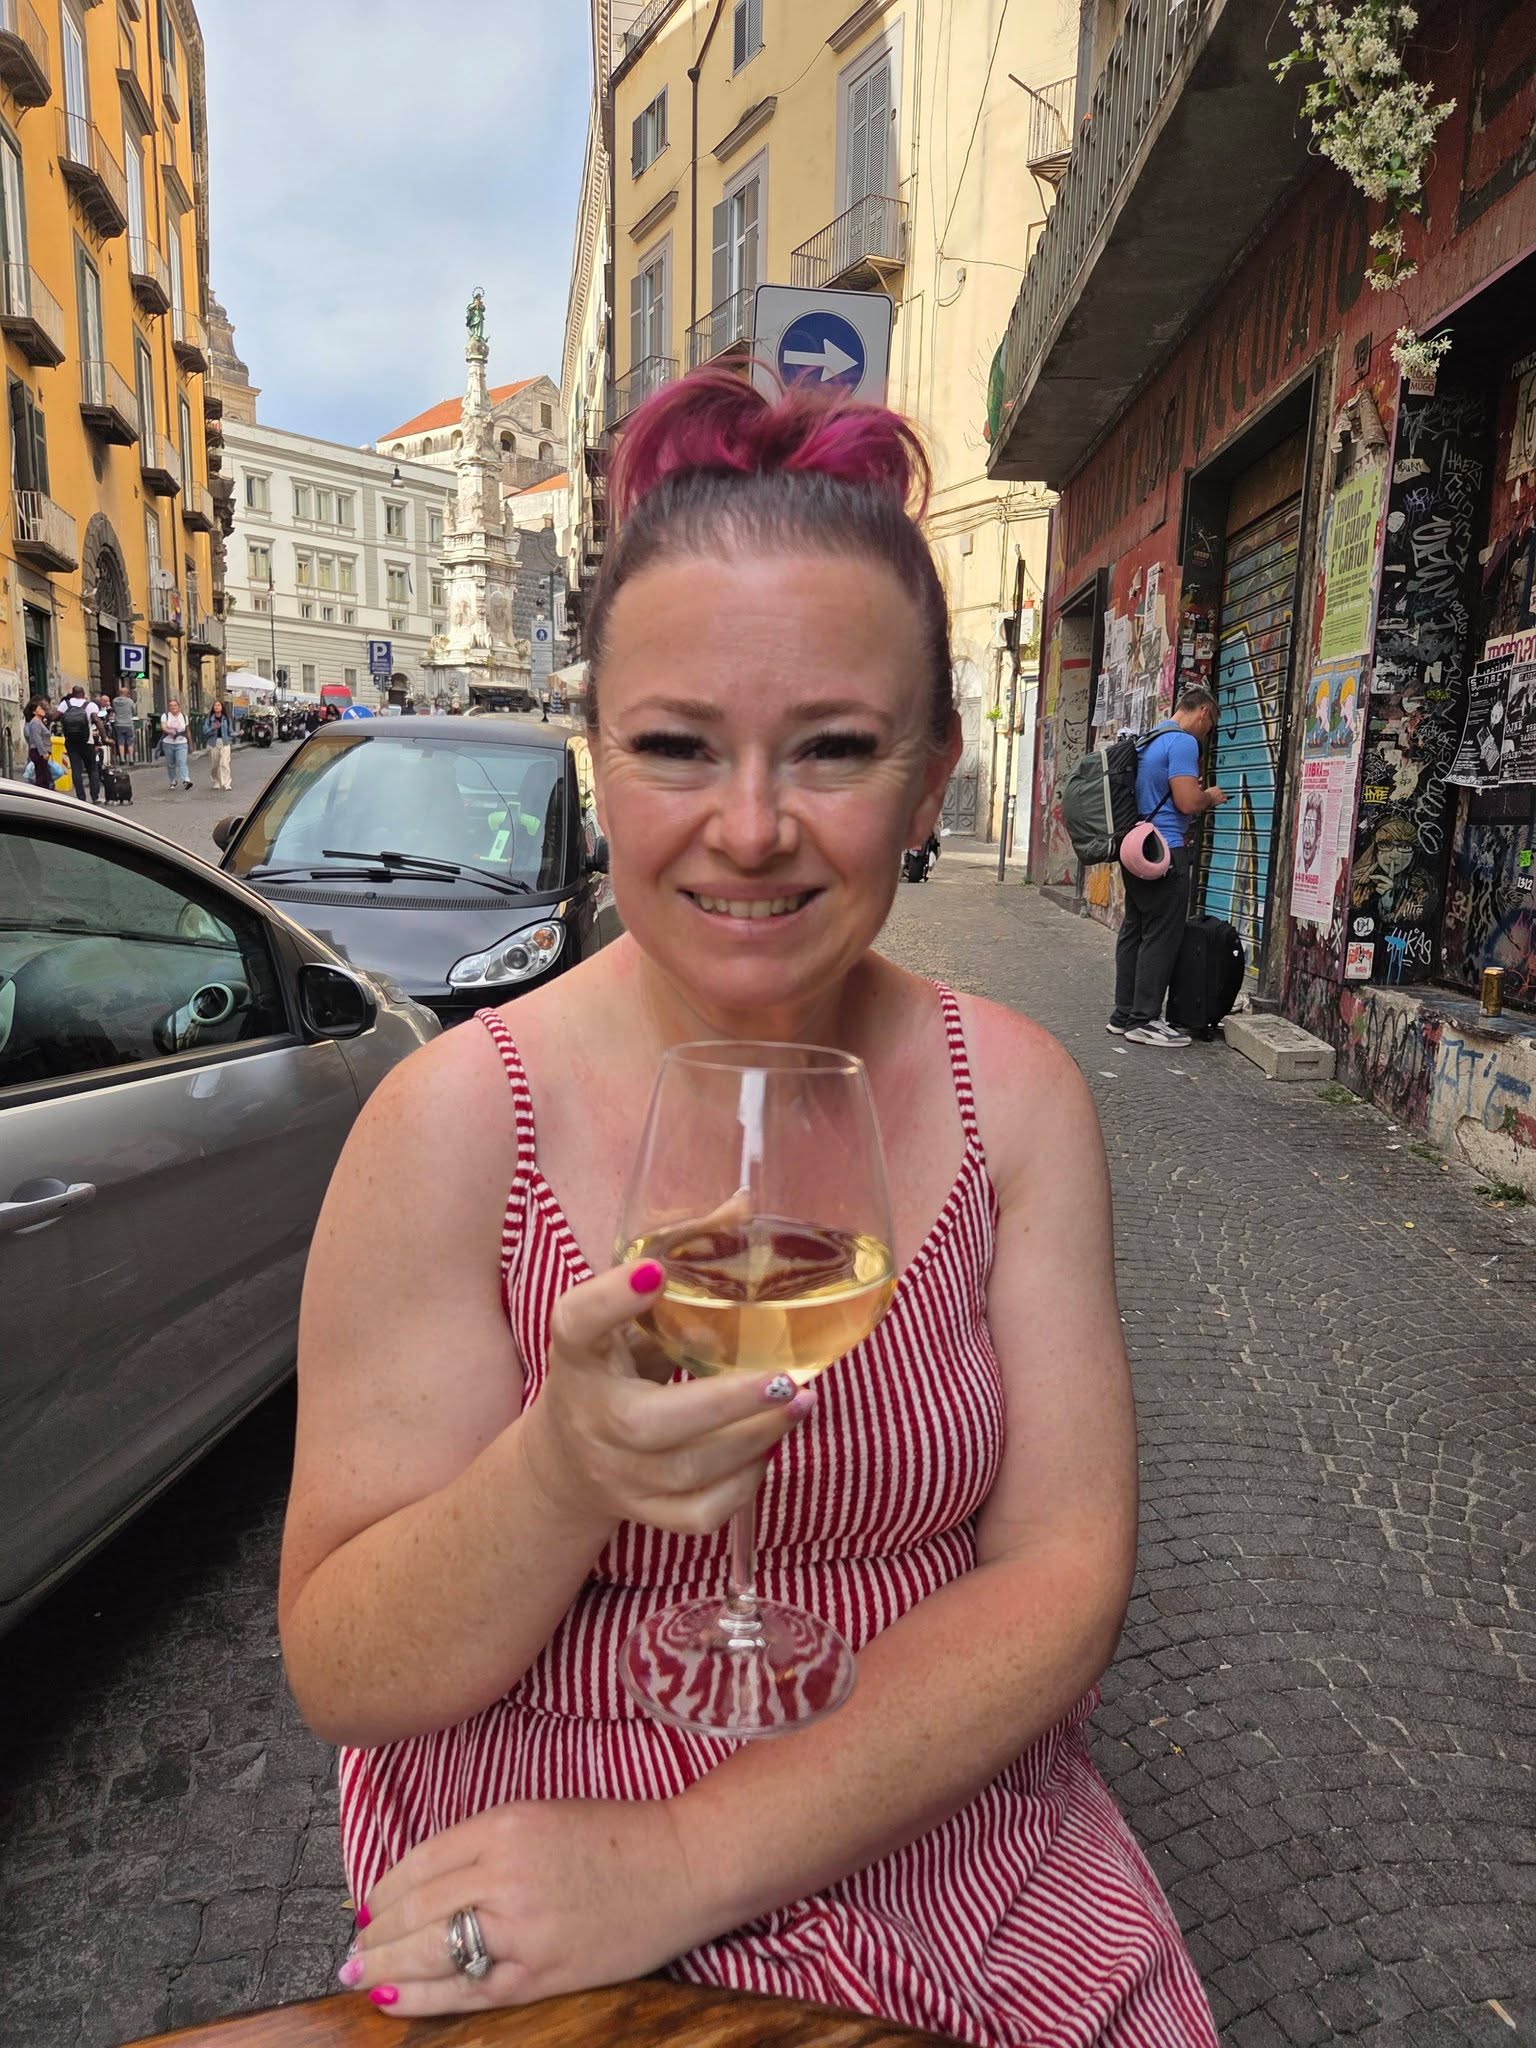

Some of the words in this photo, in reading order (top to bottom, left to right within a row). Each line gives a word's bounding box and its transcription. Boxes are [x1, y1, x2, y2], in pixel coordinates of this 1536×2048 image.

[1410, 382, 1435, 392] MUGO
[1336, 489, 1364, 526] TRUMP
[1332, 524, 1345, 553] NU
[1344, 511, 1372, 547] GUAPP
[1339, 538, 1370, 575] CARTON
[124, 648, 142, 669] P
[373, 642, 388, 662] P
[1517, 876, 1534, 891] 1312
